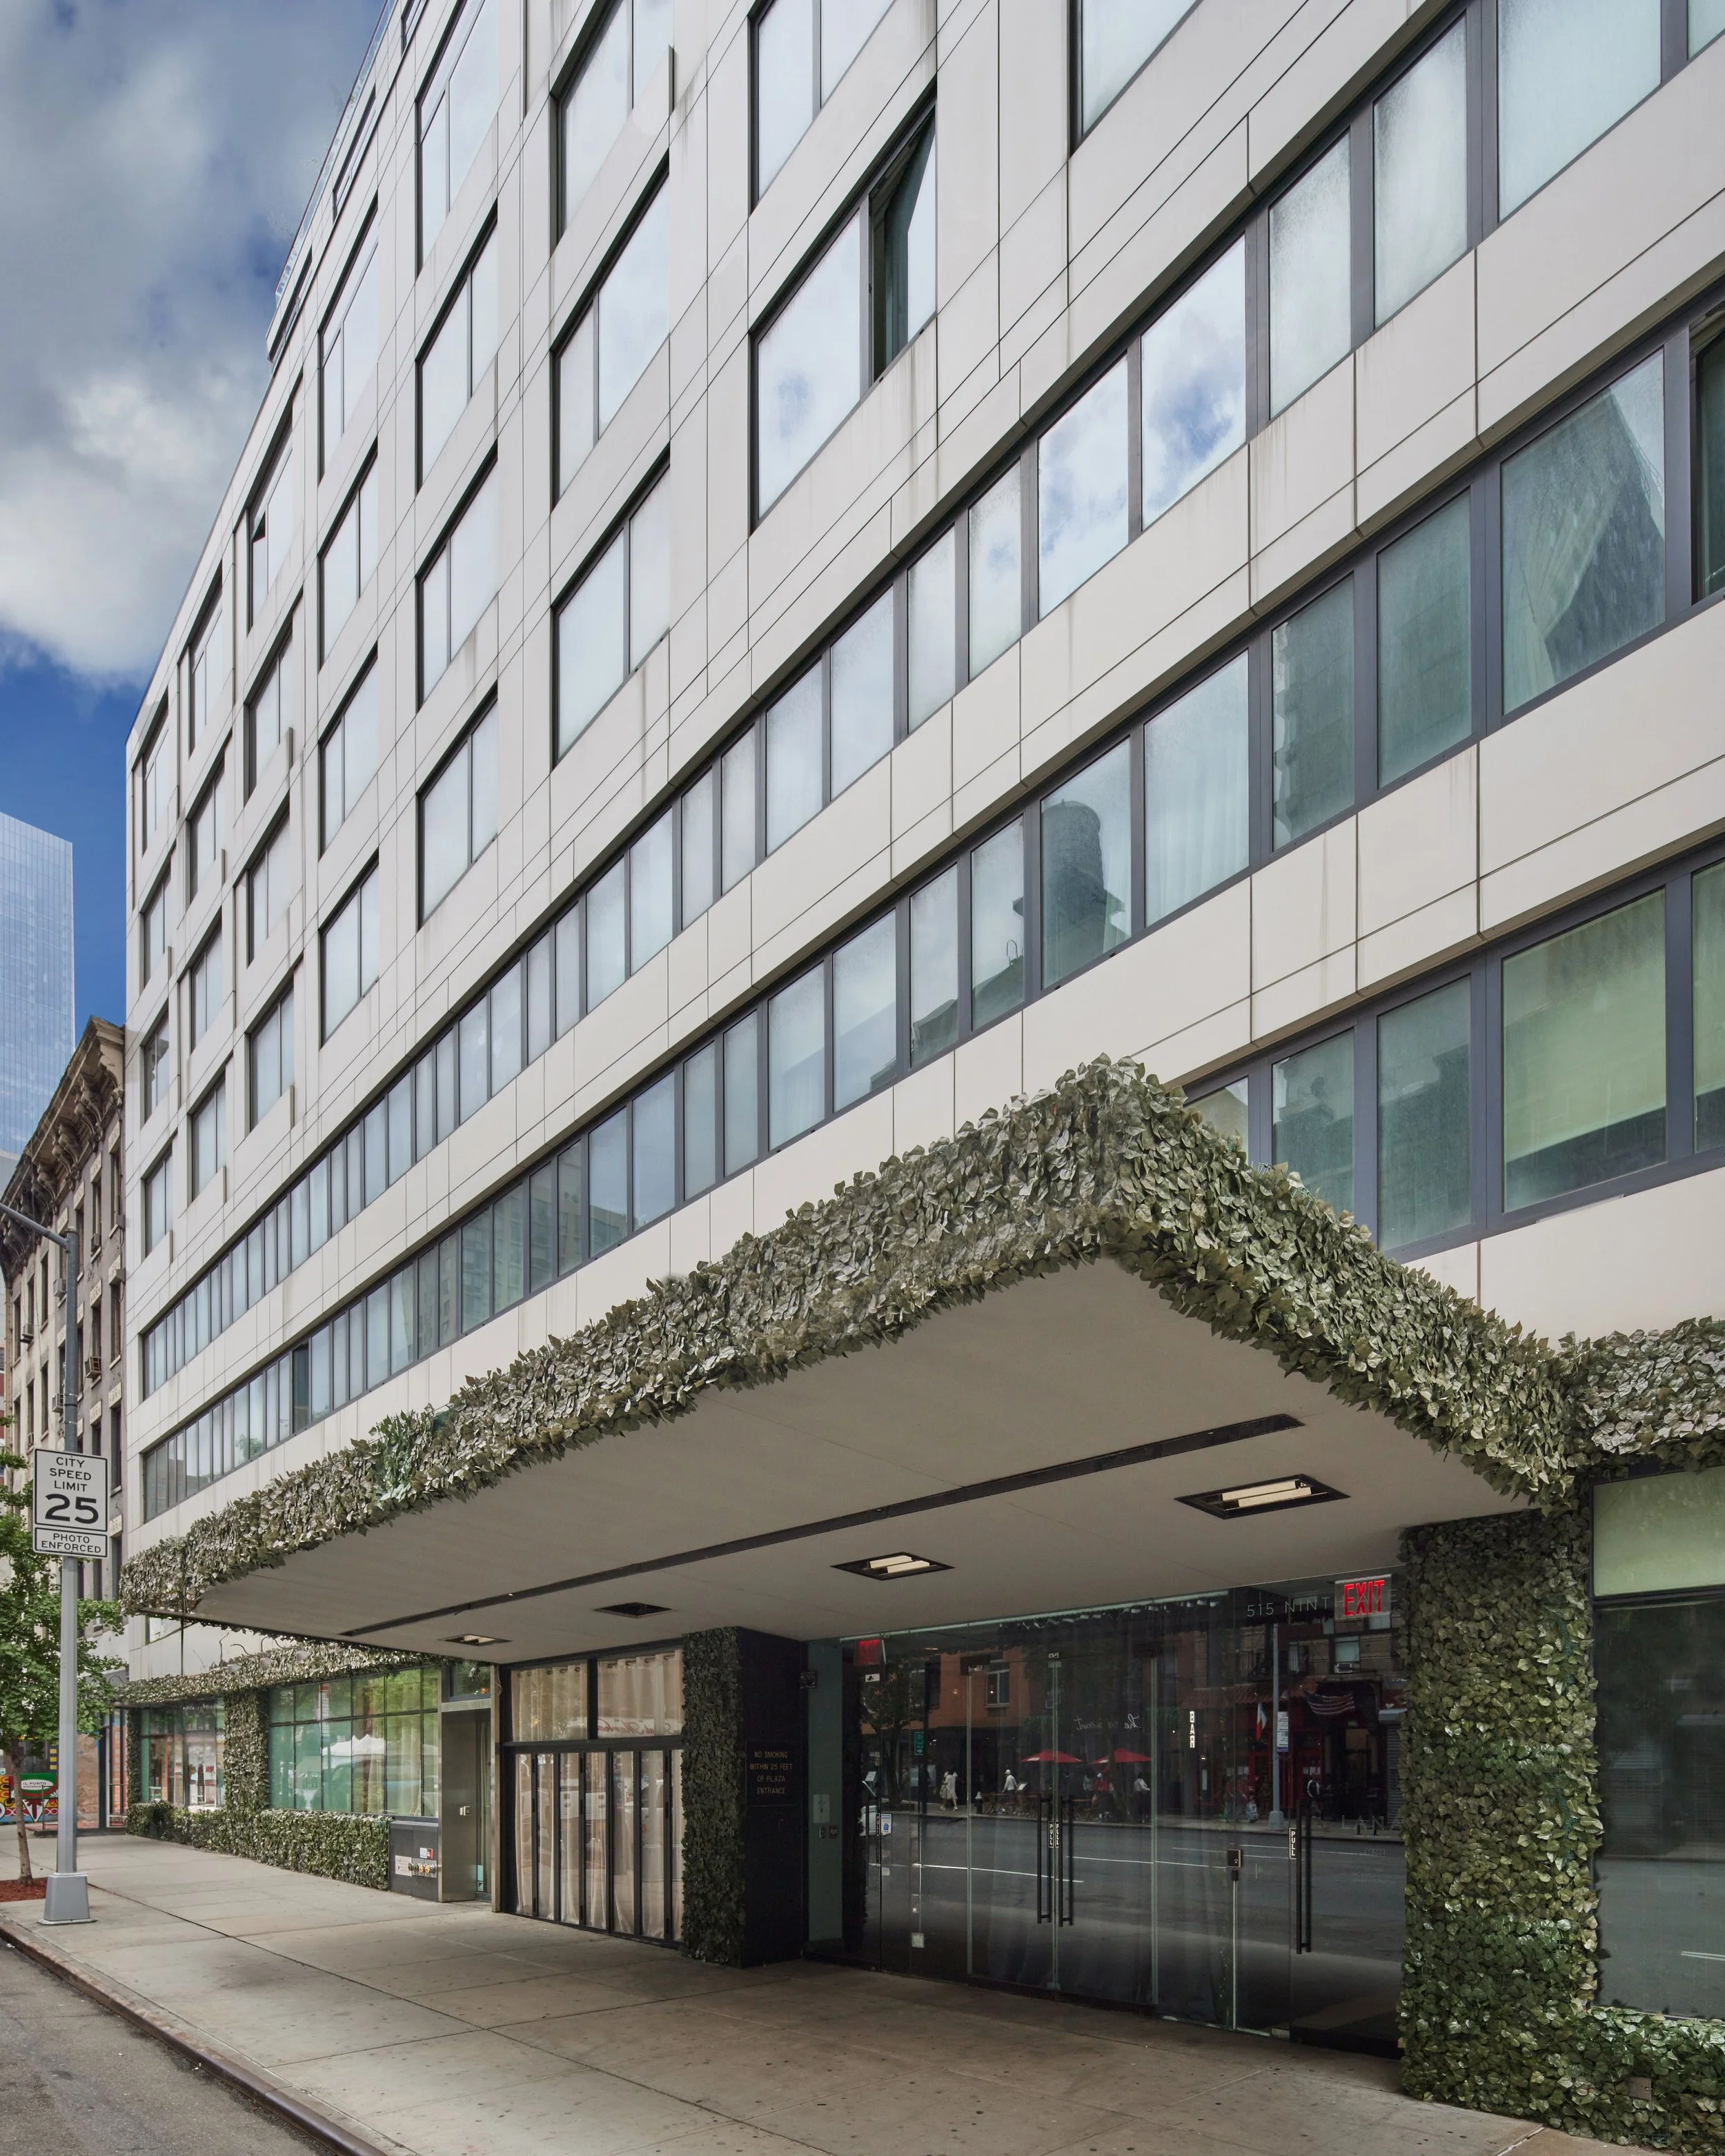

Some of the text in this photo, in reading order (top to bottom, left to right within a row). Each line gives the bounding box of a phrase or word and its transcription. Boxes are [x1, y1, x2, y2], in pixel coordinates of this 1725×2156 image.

[56, 1456, 85, 1468] CITY
[50, 1467, 92, 1481] SPEED
[54, 1481, 88, 1492] LIMIT
[45, 1494, 99, 1524] 25
[53, 1533, 90, 1543] PHOTO
[41, 1541, 101, 1553] ENFORCED
[1343, 1579, 1385, 1616] EXIT
[1247, 1603, 1274, 1617] 515
